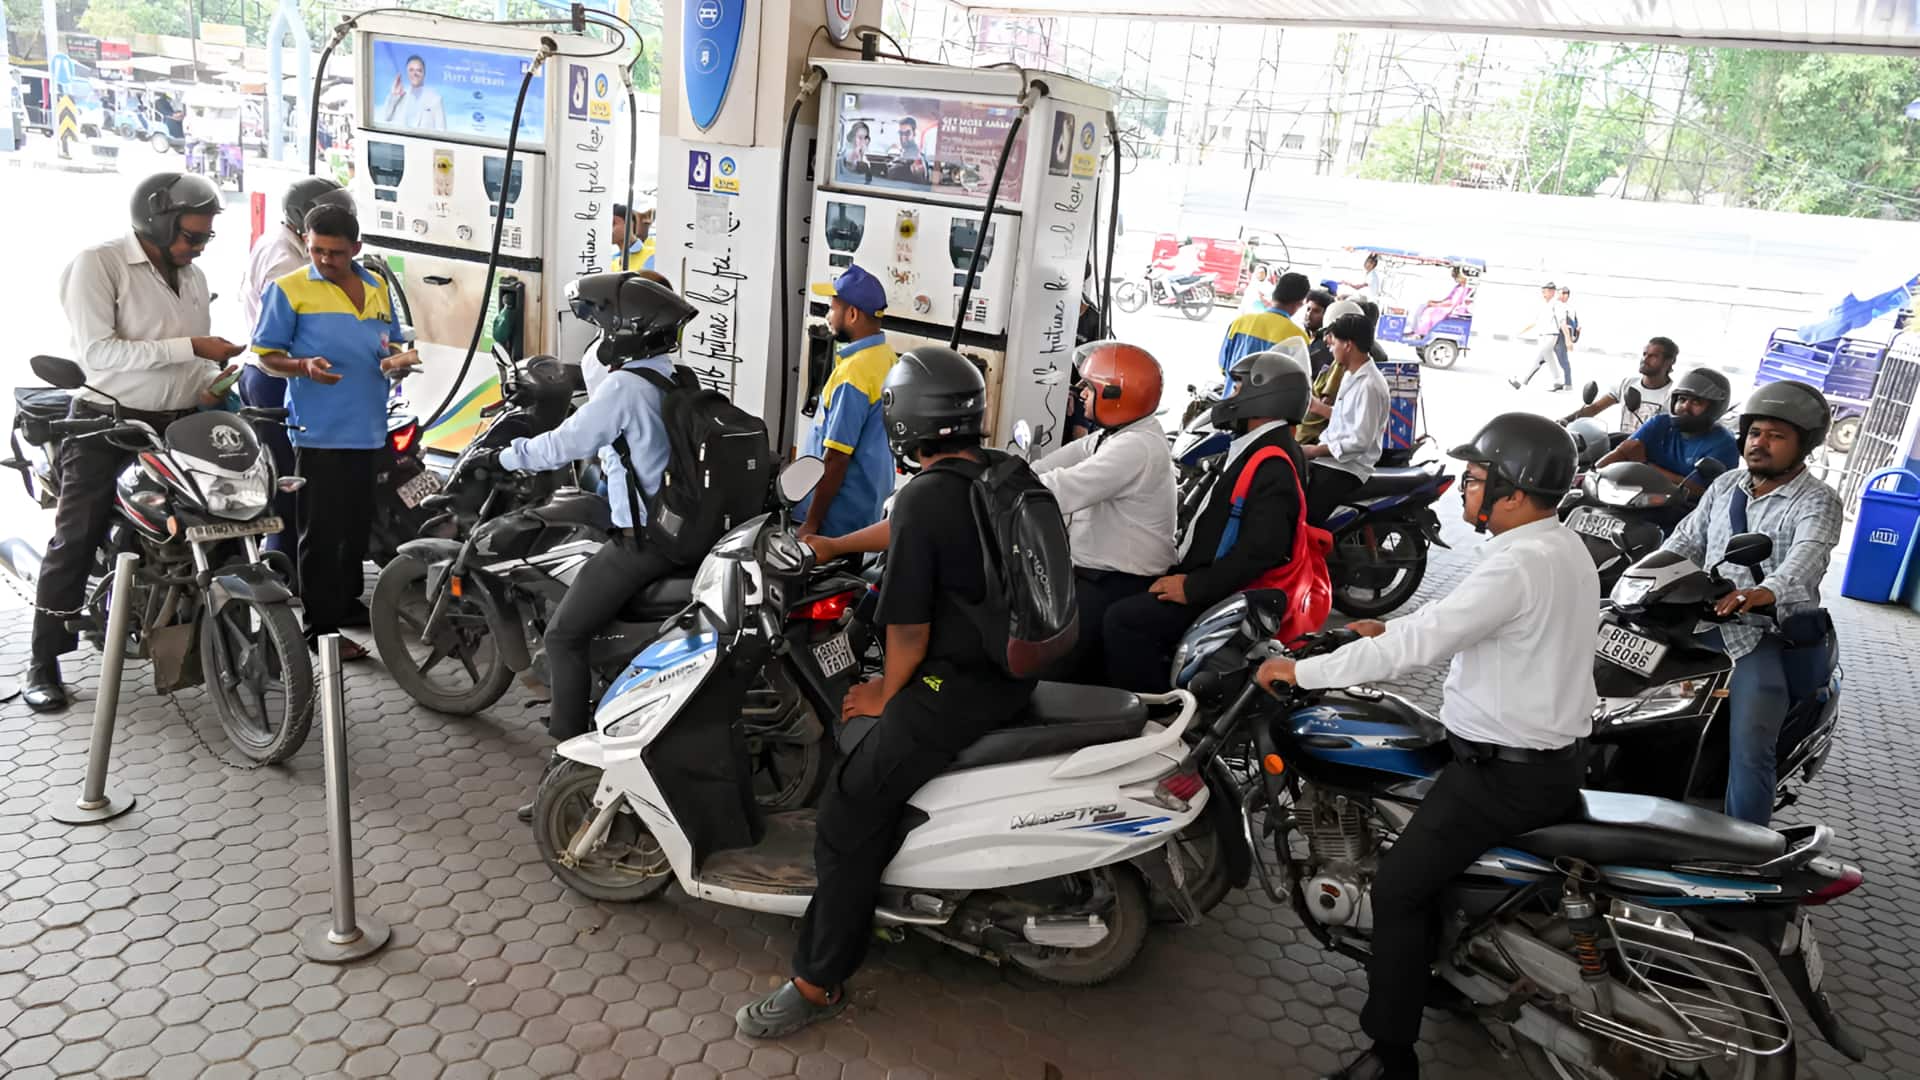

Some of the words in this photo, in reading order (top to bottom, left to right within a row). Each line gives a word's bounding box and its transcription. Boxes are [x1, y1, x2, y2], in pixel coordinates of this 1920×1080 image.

[575, 160, 606, 194] feel
[576, 228, 602, 277] future
[687, 312, 743, 363] future
[1602, 640, 1650, 669] L8086
[1609, 628, 1658, 656] BR01J
